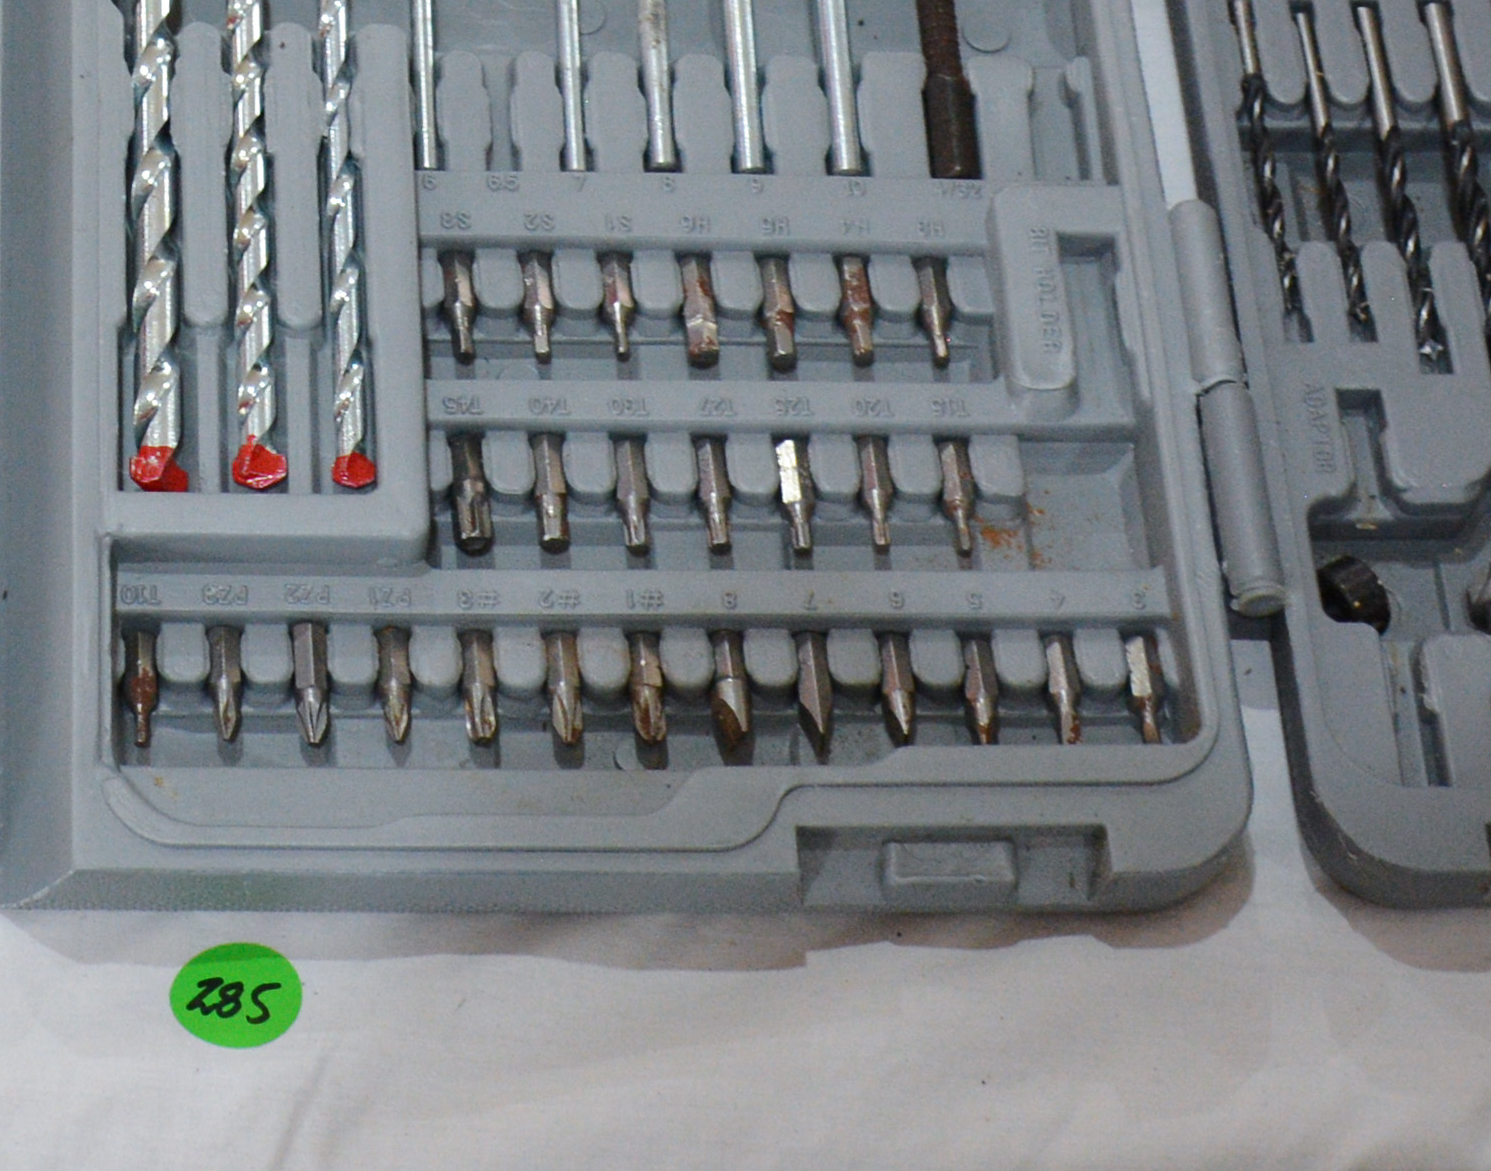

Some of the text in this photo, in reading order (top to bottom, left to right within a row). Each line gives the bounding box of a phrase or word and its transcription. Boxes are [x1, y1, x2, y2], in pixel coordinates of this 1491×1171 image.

[523, 212, 555, 233] S2
[528, 395, 572, 417] T40
[700, 396, 738, 417] T27
[775, 397, 817, 418] T25
[855, 398, 895, 418] T20
[120, 584, 163, 606] T10
[202, 583, 250, 605] PZ3
[284, 583, 332, 605] PZ2
[369, 587, 413, 608] PZ1
[539, 589, 582, 609] #2
[625, 589, 666, 610] #1
[186, 977, 281, 1024] 285
